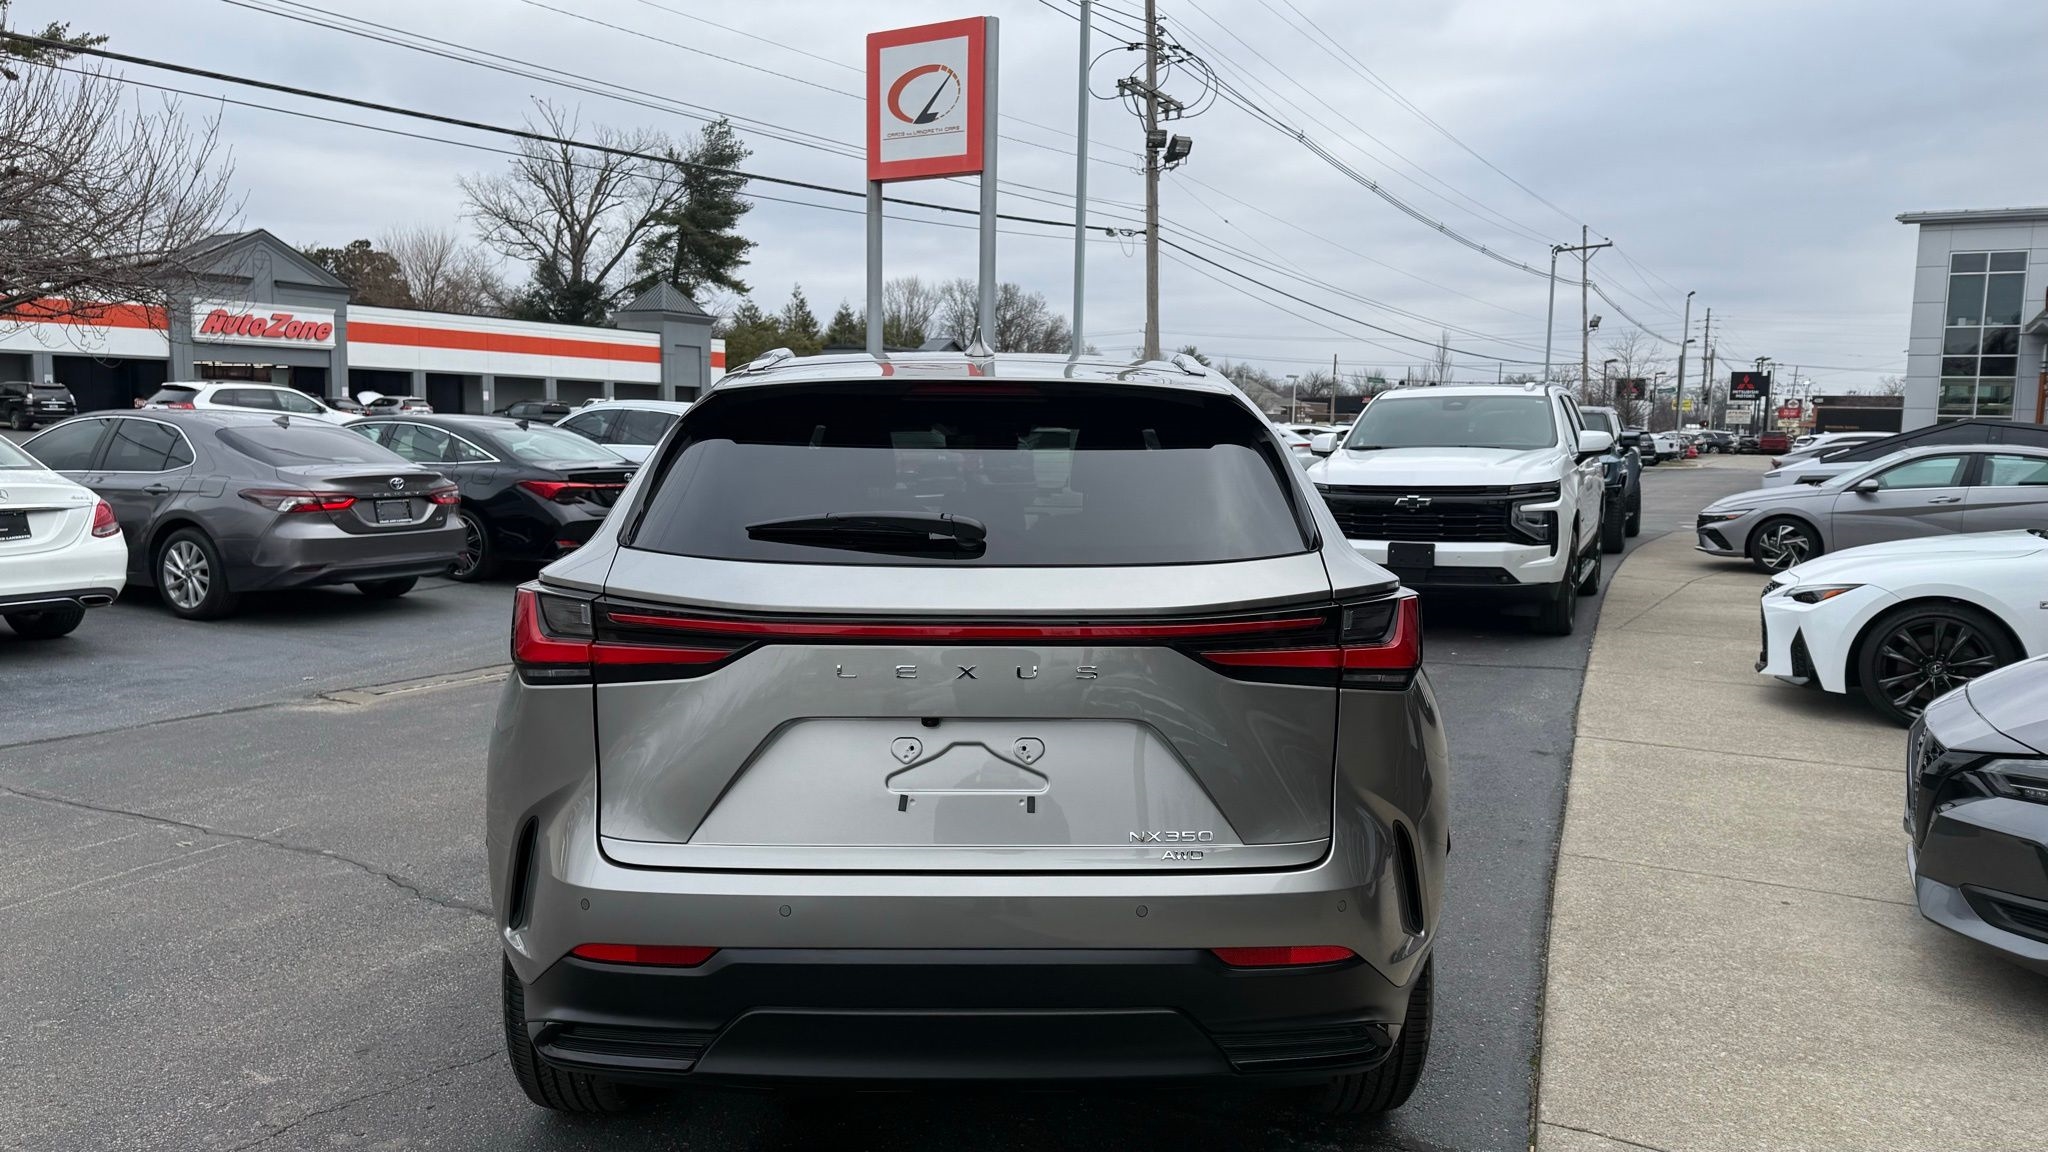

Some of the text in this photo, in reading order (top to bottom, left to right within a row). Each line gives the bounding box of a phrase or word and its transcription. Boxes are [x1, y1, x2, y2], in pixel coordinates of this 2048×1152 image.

[201, 309, 333, 342] AutoZone
[836, 664, 1098, 680] LEXUS
[1161, 850, 1204, 861] AWD
